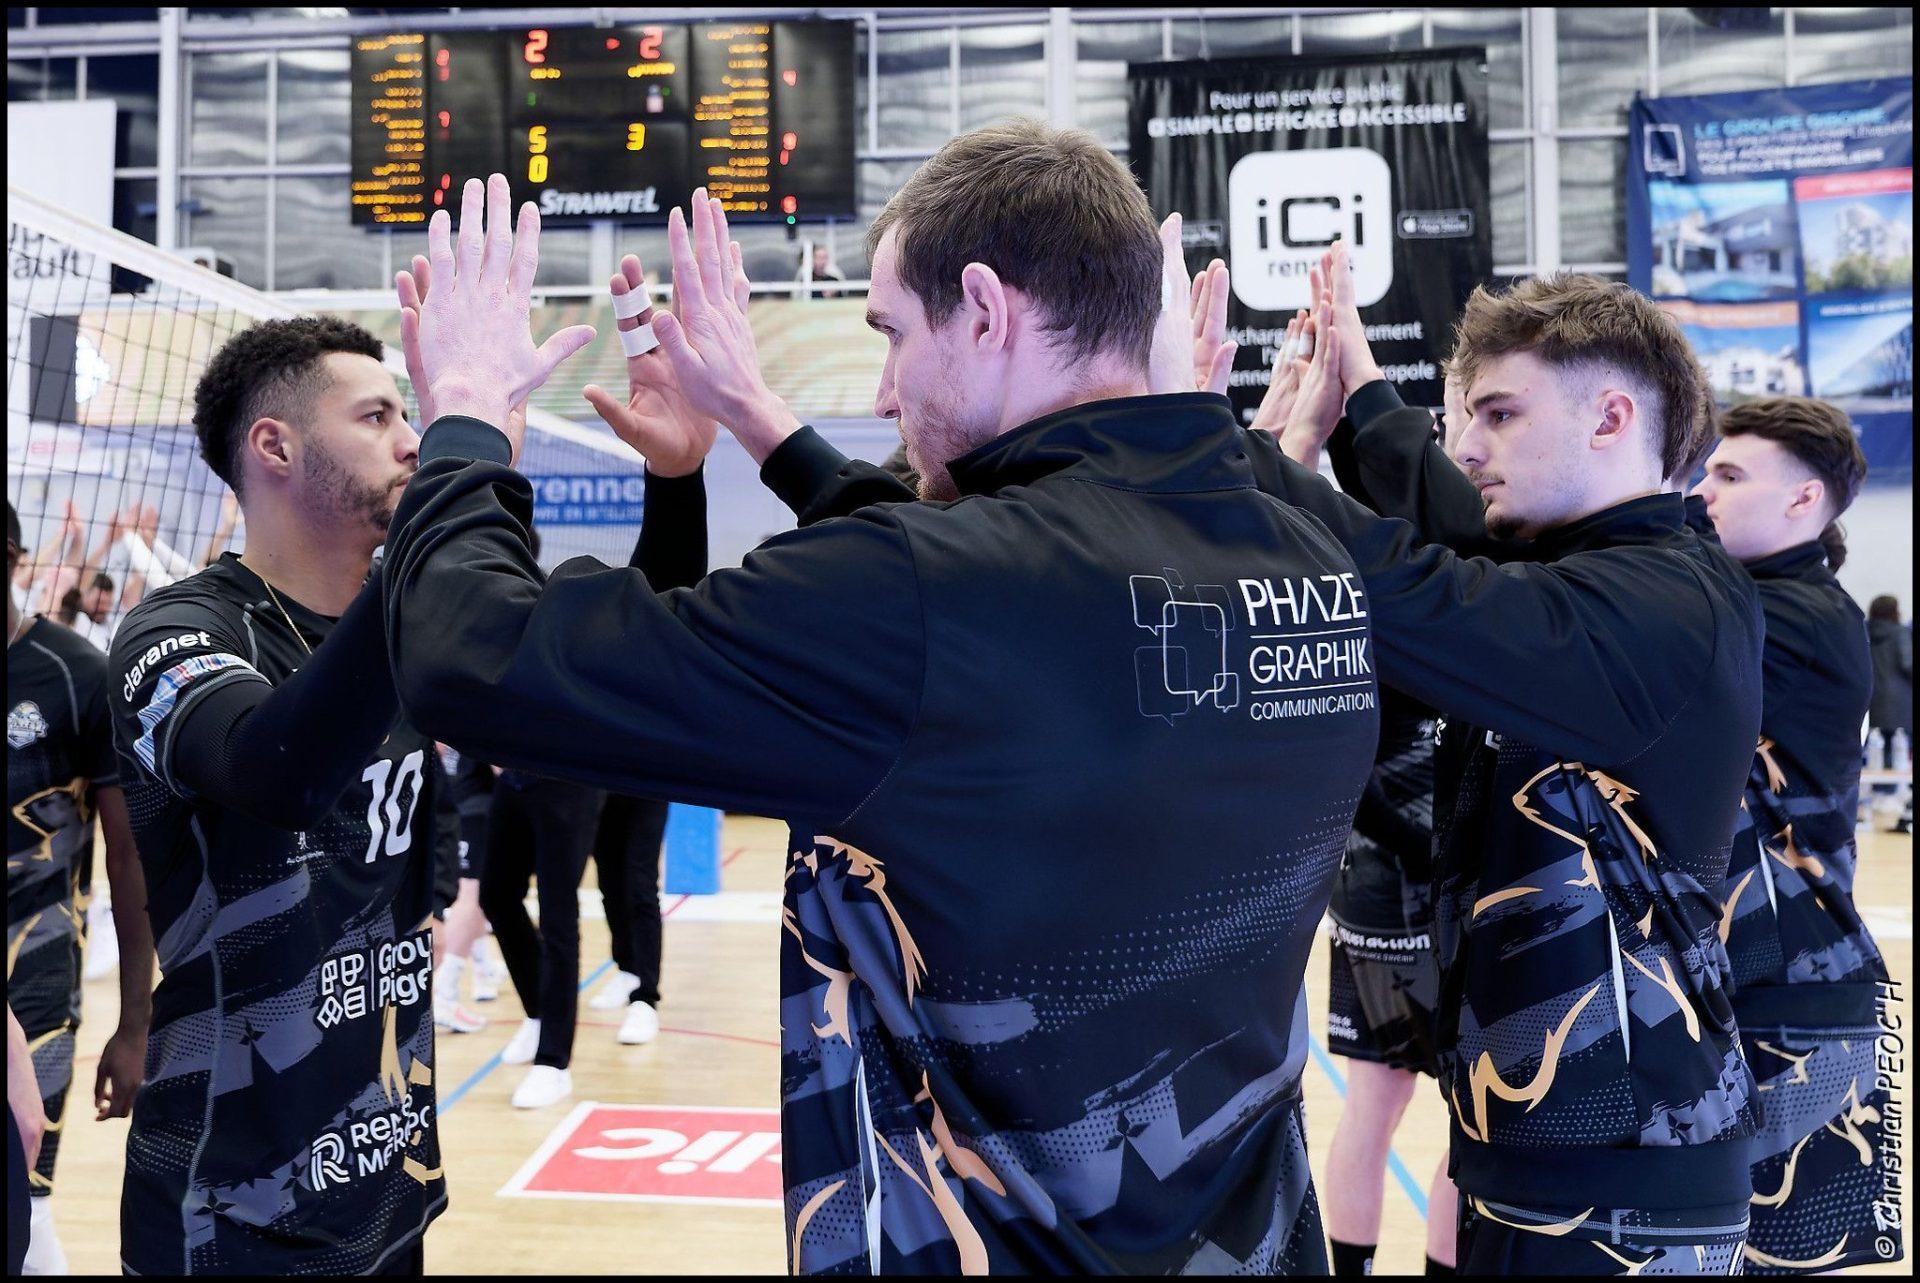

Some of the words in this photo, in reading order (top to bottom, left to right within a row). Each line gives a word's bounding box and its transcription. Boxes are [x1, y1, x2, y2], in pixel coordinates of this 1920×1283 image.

[524, 29, 548, 63] 2
[639, 26, 663, 60] 2
[1210, 90, 1251, 110] Pour
[1254, 90, 1280, 108] un
[1281, 87, 1346, 106] service
[1166, 114, 1236, 137] SIMPLE
[1254, 109, 1339, 132] EFFICACE
[1358, 102, 1467, 126] ACCESSIBLE
[528, 125, 547, 154] 5
[626, 122, 646, 151] 3
[528, 154, 548, 183] 0
[1362, 320, 1424, 342] ement
[1229, 369, 1271, 388] enne
[1381, 360, 1437, 385] opole
[123, 631, 211, 703] claranet
[1250, 637, 1371, 684] GRAPHIK
[1250, 692, 1375, 721] COMMUNICATION
[362, 749, 424, 864] 10
